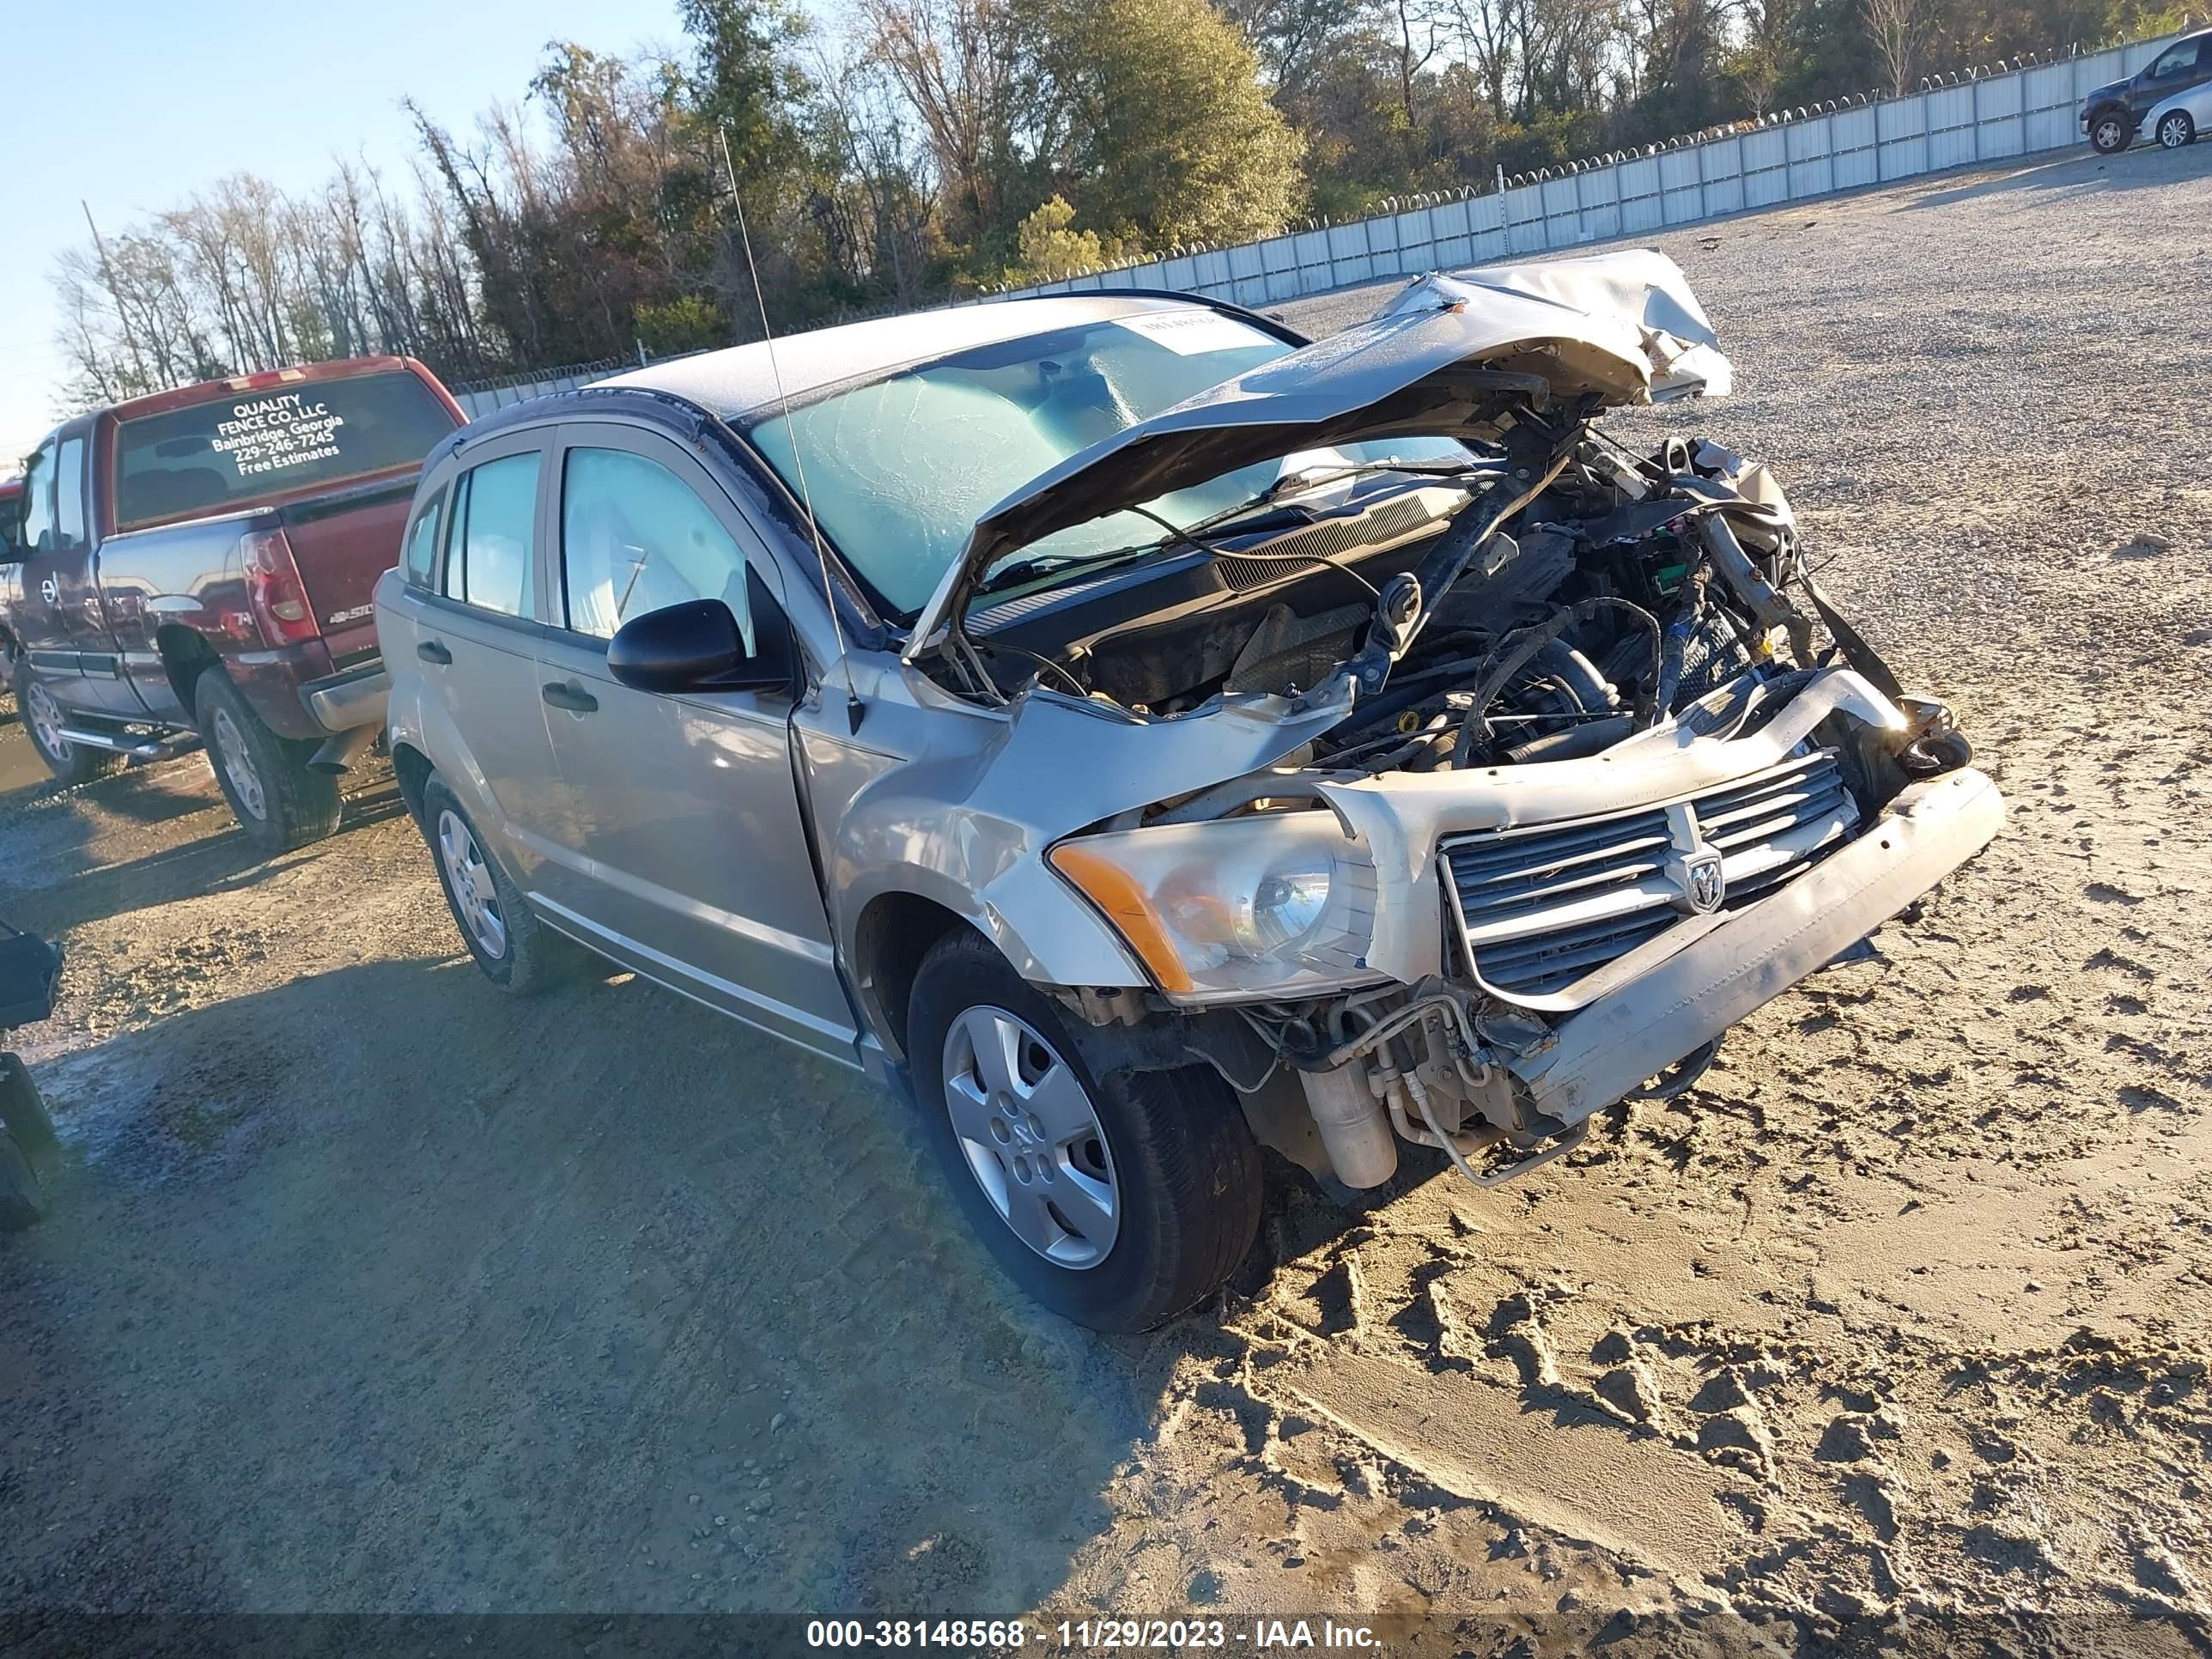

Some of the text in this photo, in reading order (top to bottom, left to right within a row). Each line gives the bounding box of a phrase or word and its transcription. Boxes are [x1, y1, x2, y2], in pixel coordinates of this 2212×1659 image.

[217, 416, 267, 436] FENCE
[298, 403, 328, 420] LLC
[234, 394, 300, 417] QUALITY
[290, 416, 343, 434] Georgia
[233, 429, 335, 463] 229-246-7245
[238, 446, 339, 476] Free Estimates
